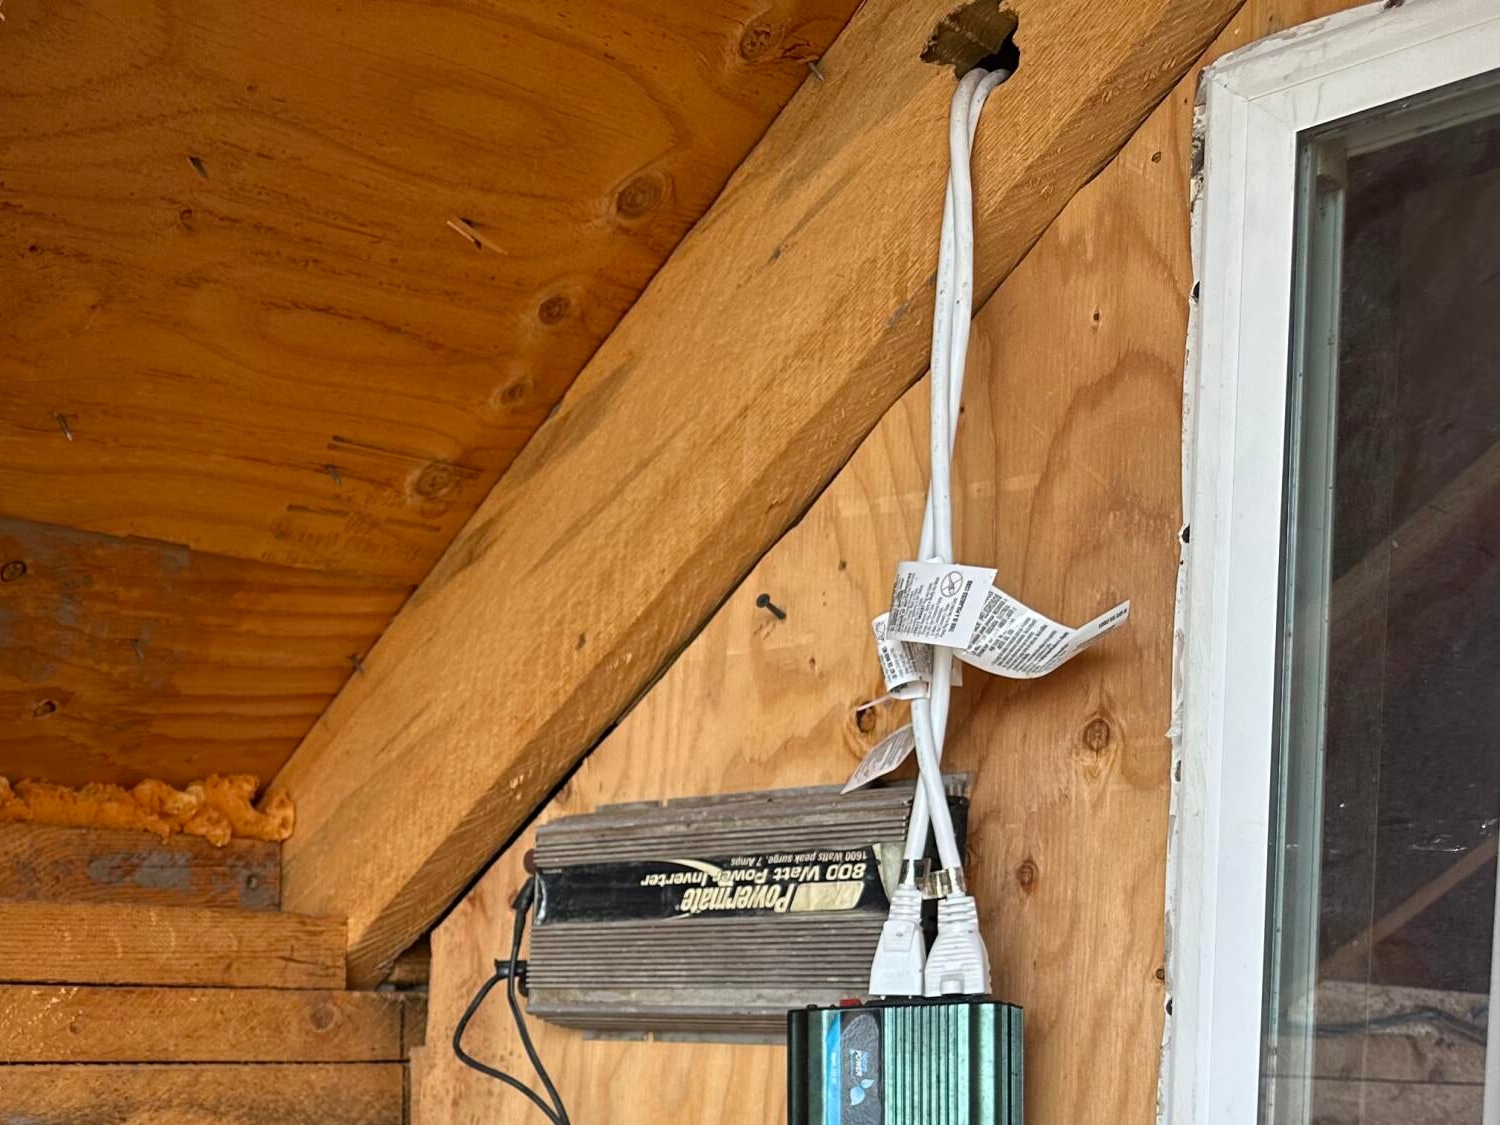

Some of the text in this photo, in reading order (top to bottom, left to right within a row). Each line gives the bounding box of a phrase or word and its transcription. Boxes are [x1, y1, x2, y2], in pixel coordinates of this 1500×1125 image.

[730, 857, 756, 866] Amps
[794, 852, 817, 864] peak
[818, 852, 844, 863] Watts
[844, 851, 868, 862] 1600
[640, 863, 867, 887] 800 Watt Power Inverter
